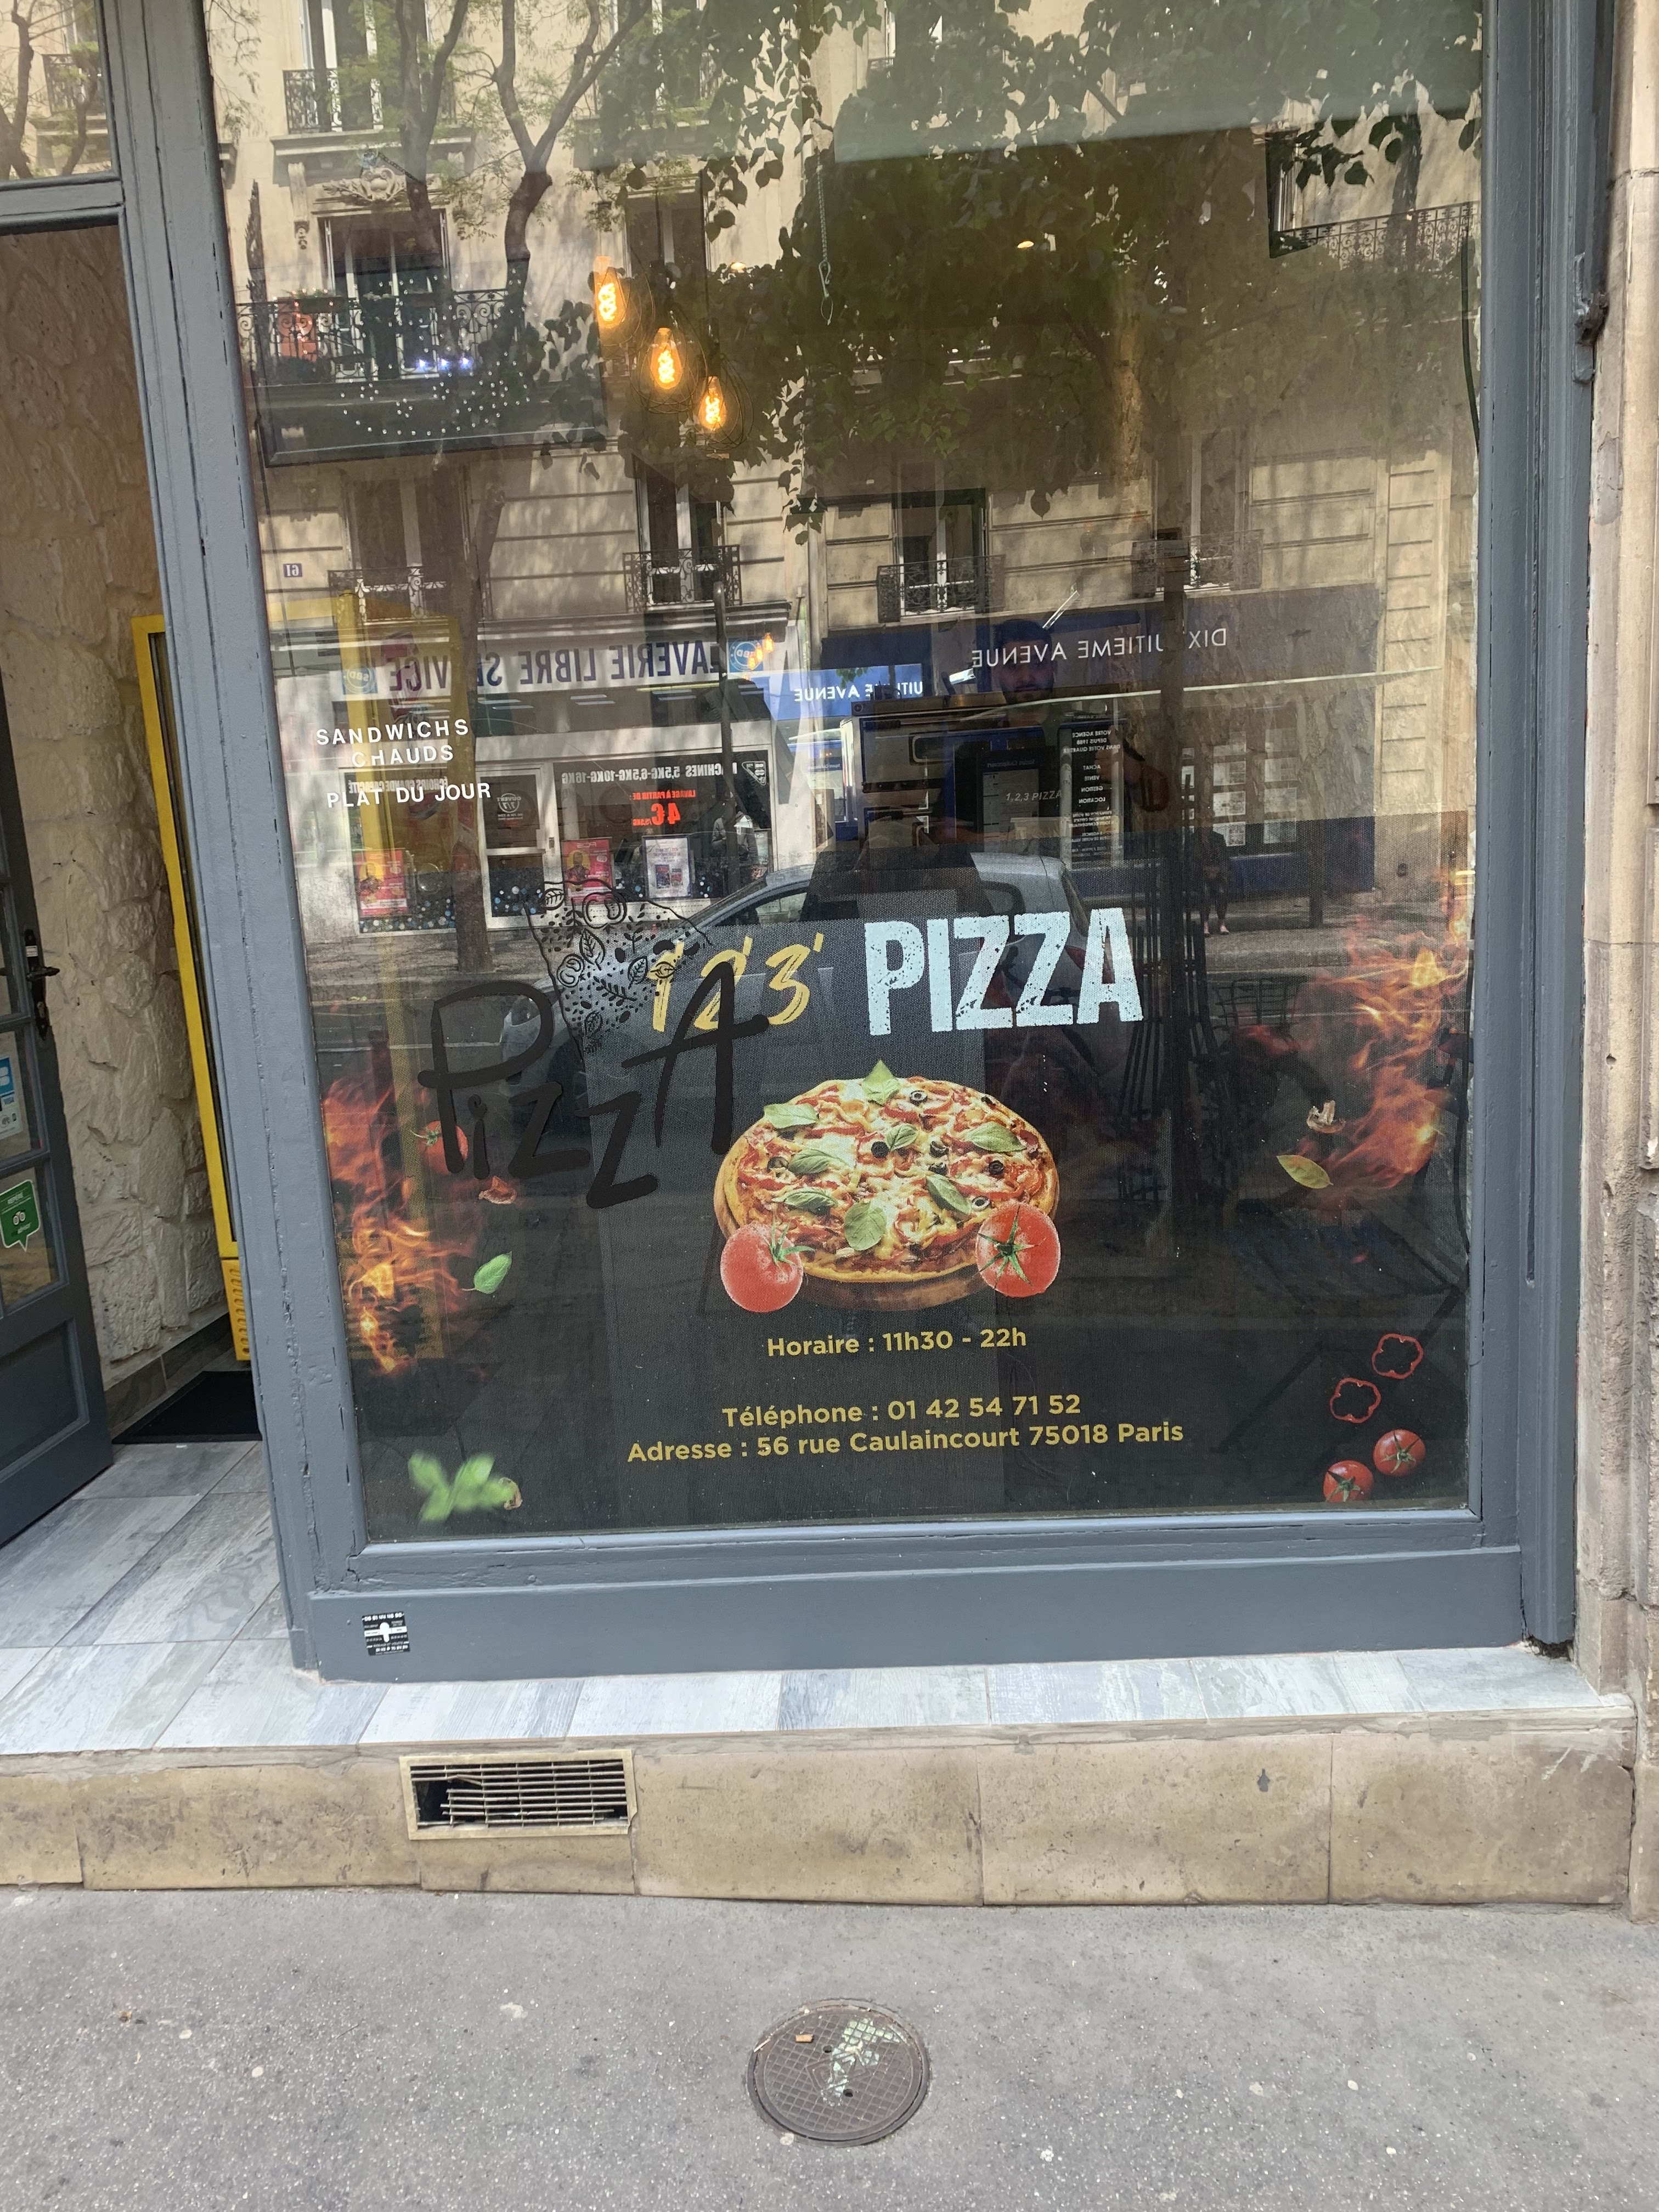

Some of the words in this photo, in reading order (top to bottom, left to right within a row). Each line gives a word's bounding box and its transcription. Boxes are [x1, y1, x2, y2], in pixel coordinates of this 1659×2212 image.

[317, 719, 469, 746] SANDWICHS
[352, 744, 453, 768] CHAUDS
[326, 789, 383, 808] PLAT
[396, 786, 424, 803] DU
[435, 782, 491, 802] JOUR
[1031, 789, 1062, 801] PIZZA
[864, 907, 1143, 1036] PIZZA
[768, 1335, 860, 1357] Horaire
[882, 1330, 953, 1352] 11h30
[980, 1327, 1026, 1348] 22h
[722, 1404, 863, 1429] Téléphone
[888, 1400, 916, 1420] 01
[926, 1398, 960, 1419] 42
[969, 1397, 1003, 1417] 54
[1012, 1395, 1038, 1415] 71
[1049, 1394, 1081, 1414] 52
[627, 1441, 732, 1463] Adresse
[757, 1436, 789, 1457] 56
[798, 1437, 841, 1454] rue
[850, 1427, 1020, 1452] Caulaincourt
[1029, 1424, 1109, 1446] 75018
[1118, 1421, 1184, 1442] Paris
